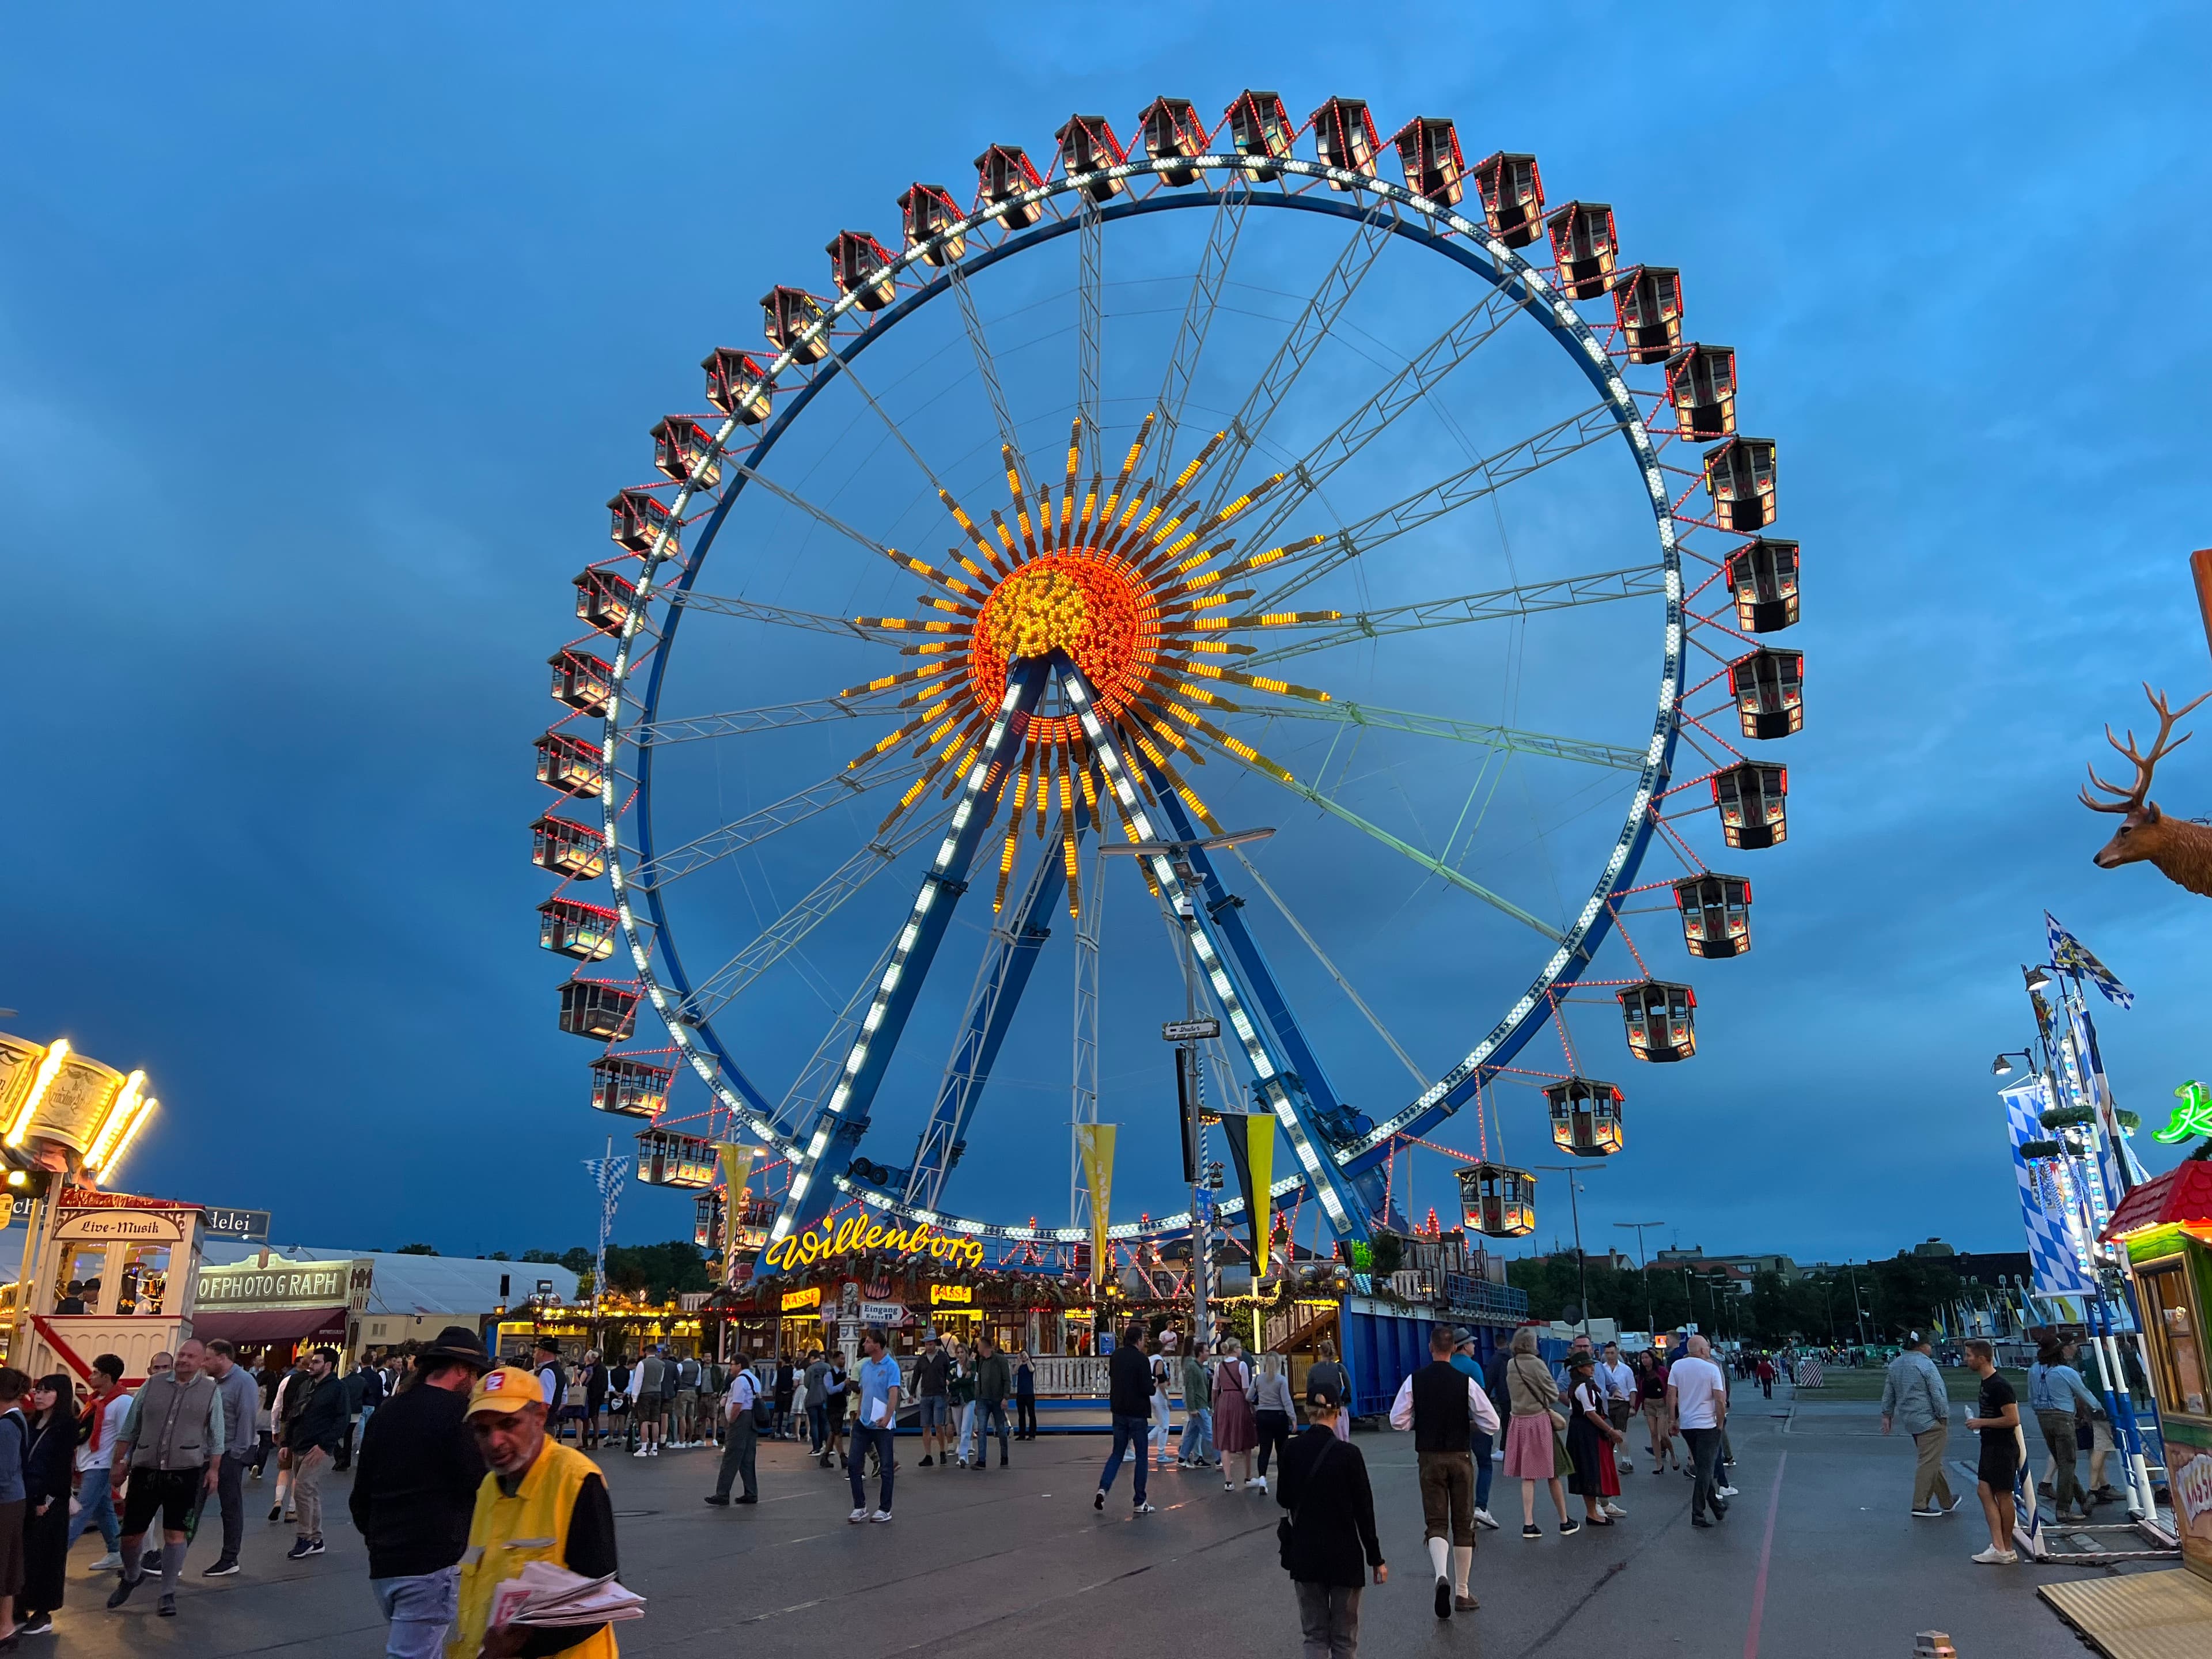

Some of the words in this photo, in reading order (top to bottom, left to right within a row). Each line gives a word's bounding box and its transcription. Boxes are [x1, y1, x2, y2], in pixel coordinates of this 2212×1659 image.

[81, 1221, 159, 1233] Live-Musik
[766, 1214, 984, 1270] Willenborg
[197, 1272, 338, 1298] OFPHOTOGRAPH
[785, 1290, 817, 1306] KASSE
[934, 1286, 968, 1299] KASSE
[864, 1305, 898, 1315] Eingang
